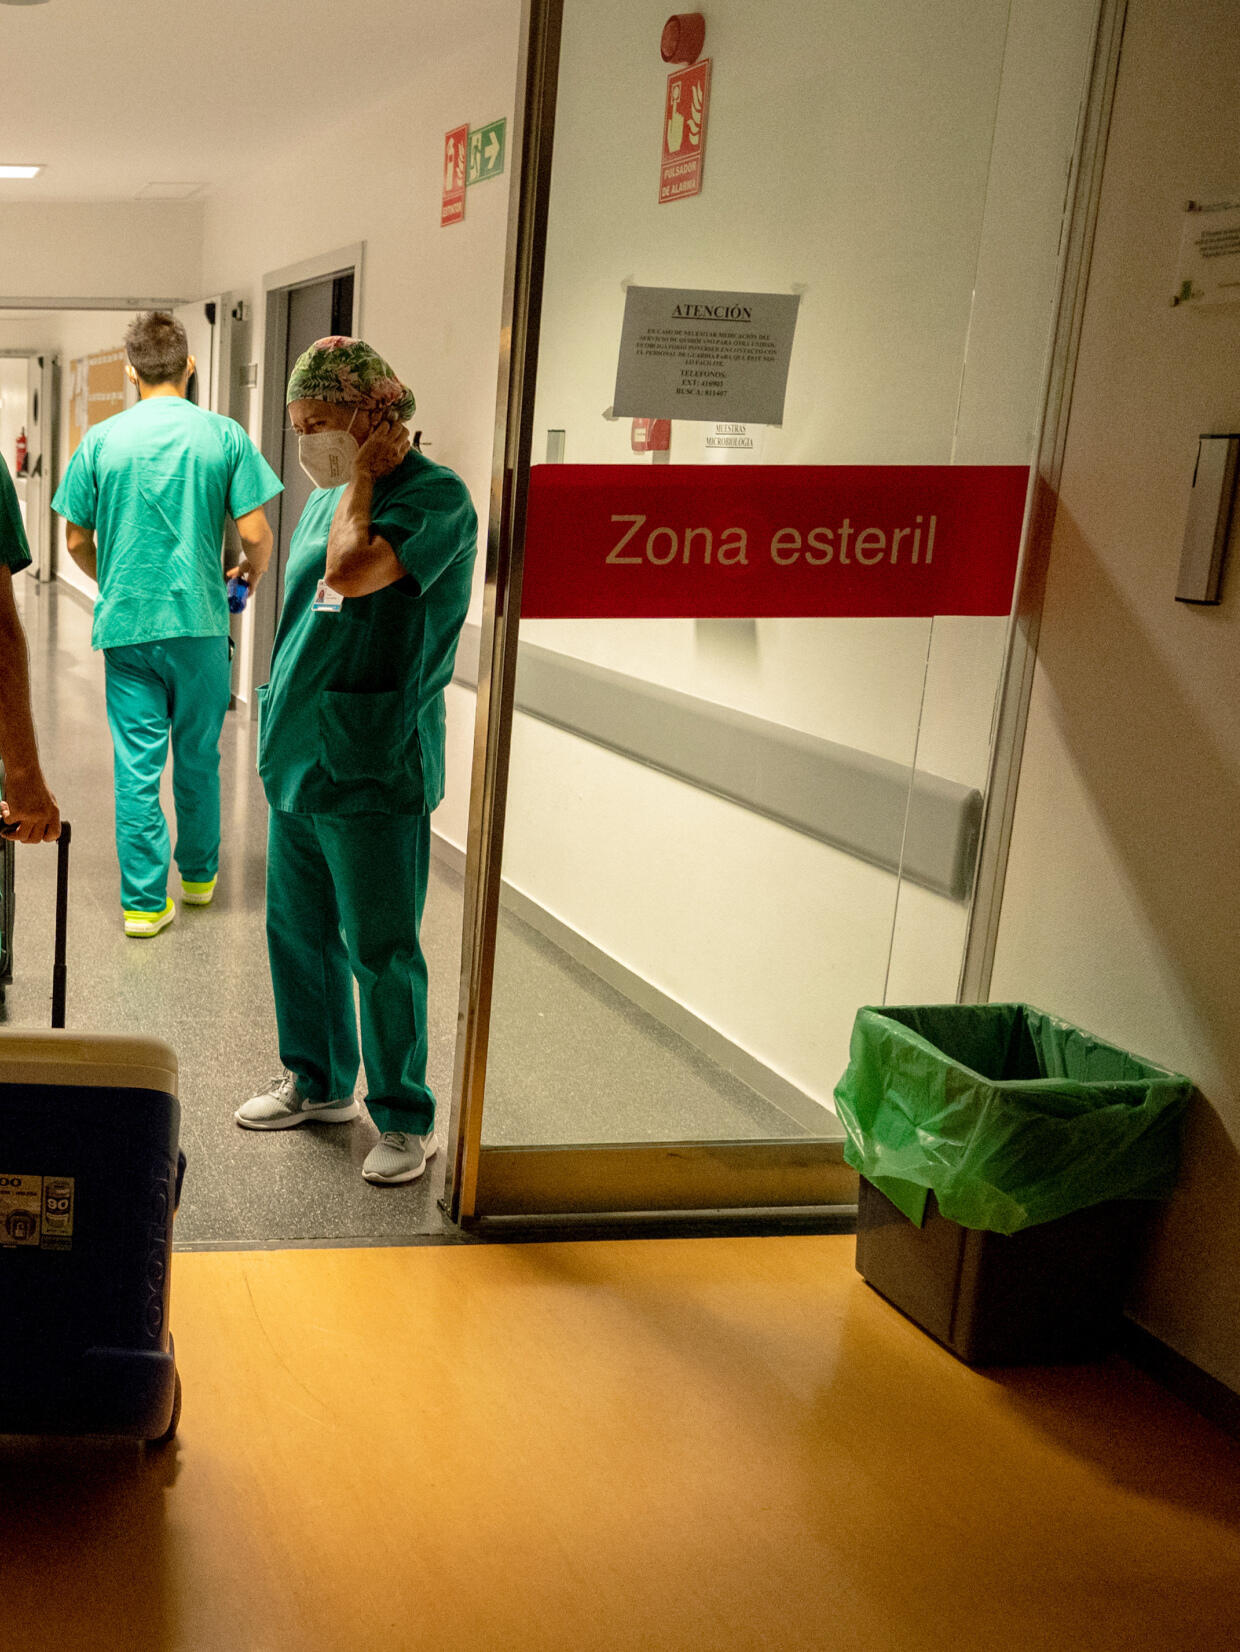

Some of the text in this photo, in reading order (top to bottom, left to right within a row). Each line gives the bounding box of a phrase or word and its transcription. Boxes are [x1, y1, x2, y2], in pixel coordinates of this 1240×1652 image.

[672, 303, 753, 319] ATENCIÓN
[605, 514, 937, 565] Zona esteril
[47, 1198, 69, 1210] 90
